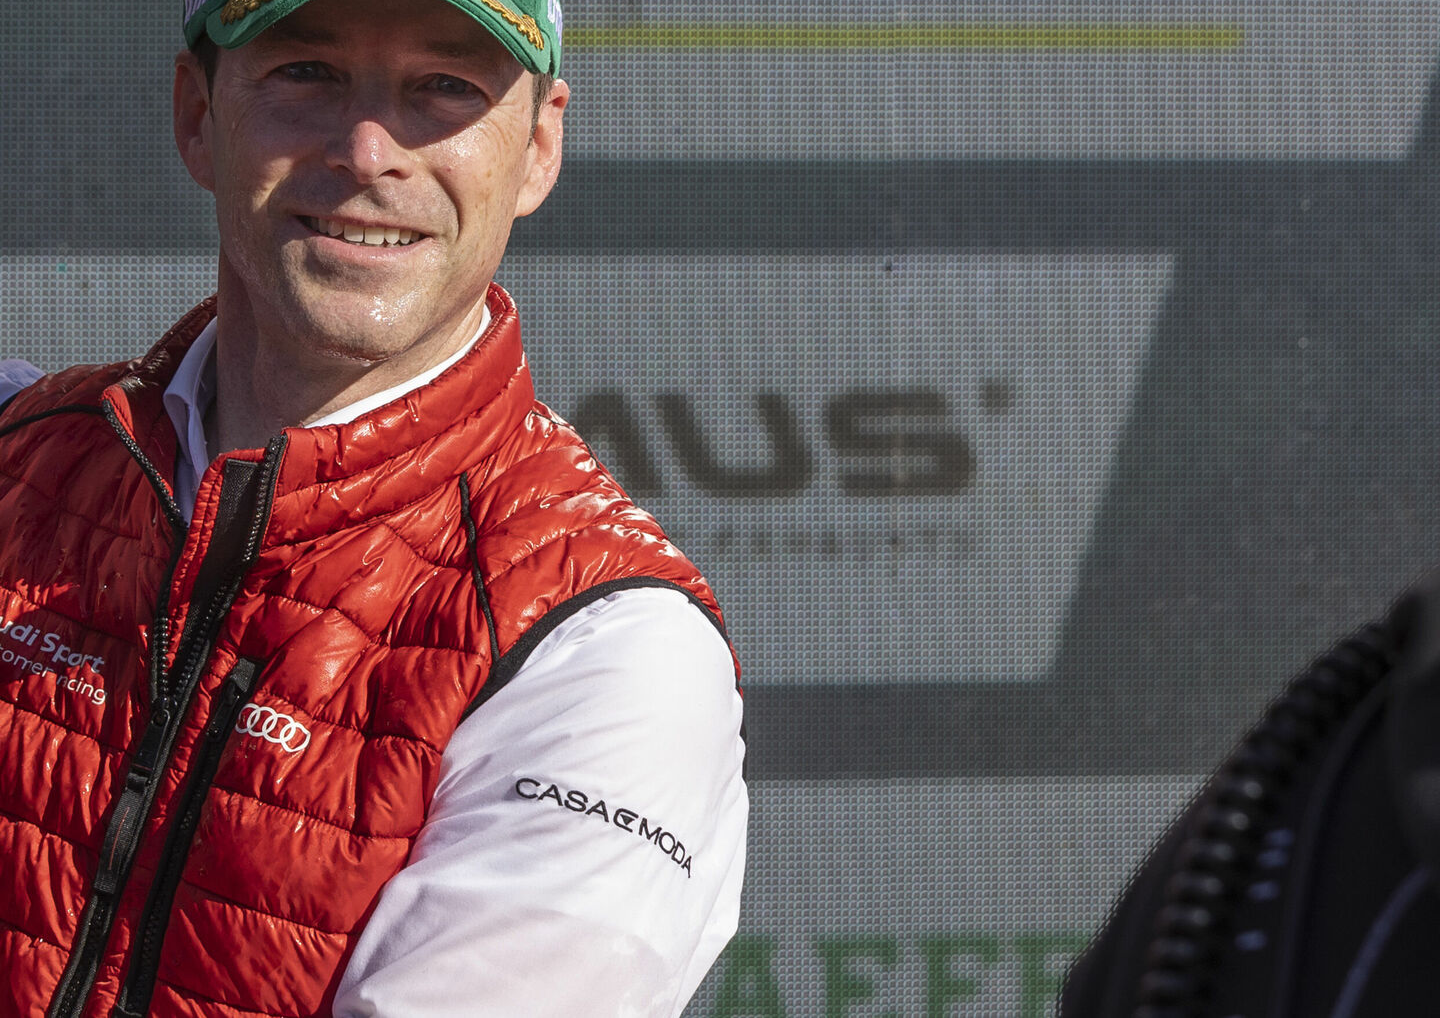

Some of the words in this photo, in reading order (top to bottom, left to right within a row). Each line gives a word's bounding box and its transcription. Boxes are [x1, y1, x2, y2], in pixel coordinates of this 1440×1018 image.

[40, 633, 105, 673] Sport
[515, 778, 609, 823] CASA
[638, 818, 692, 878] MODA
